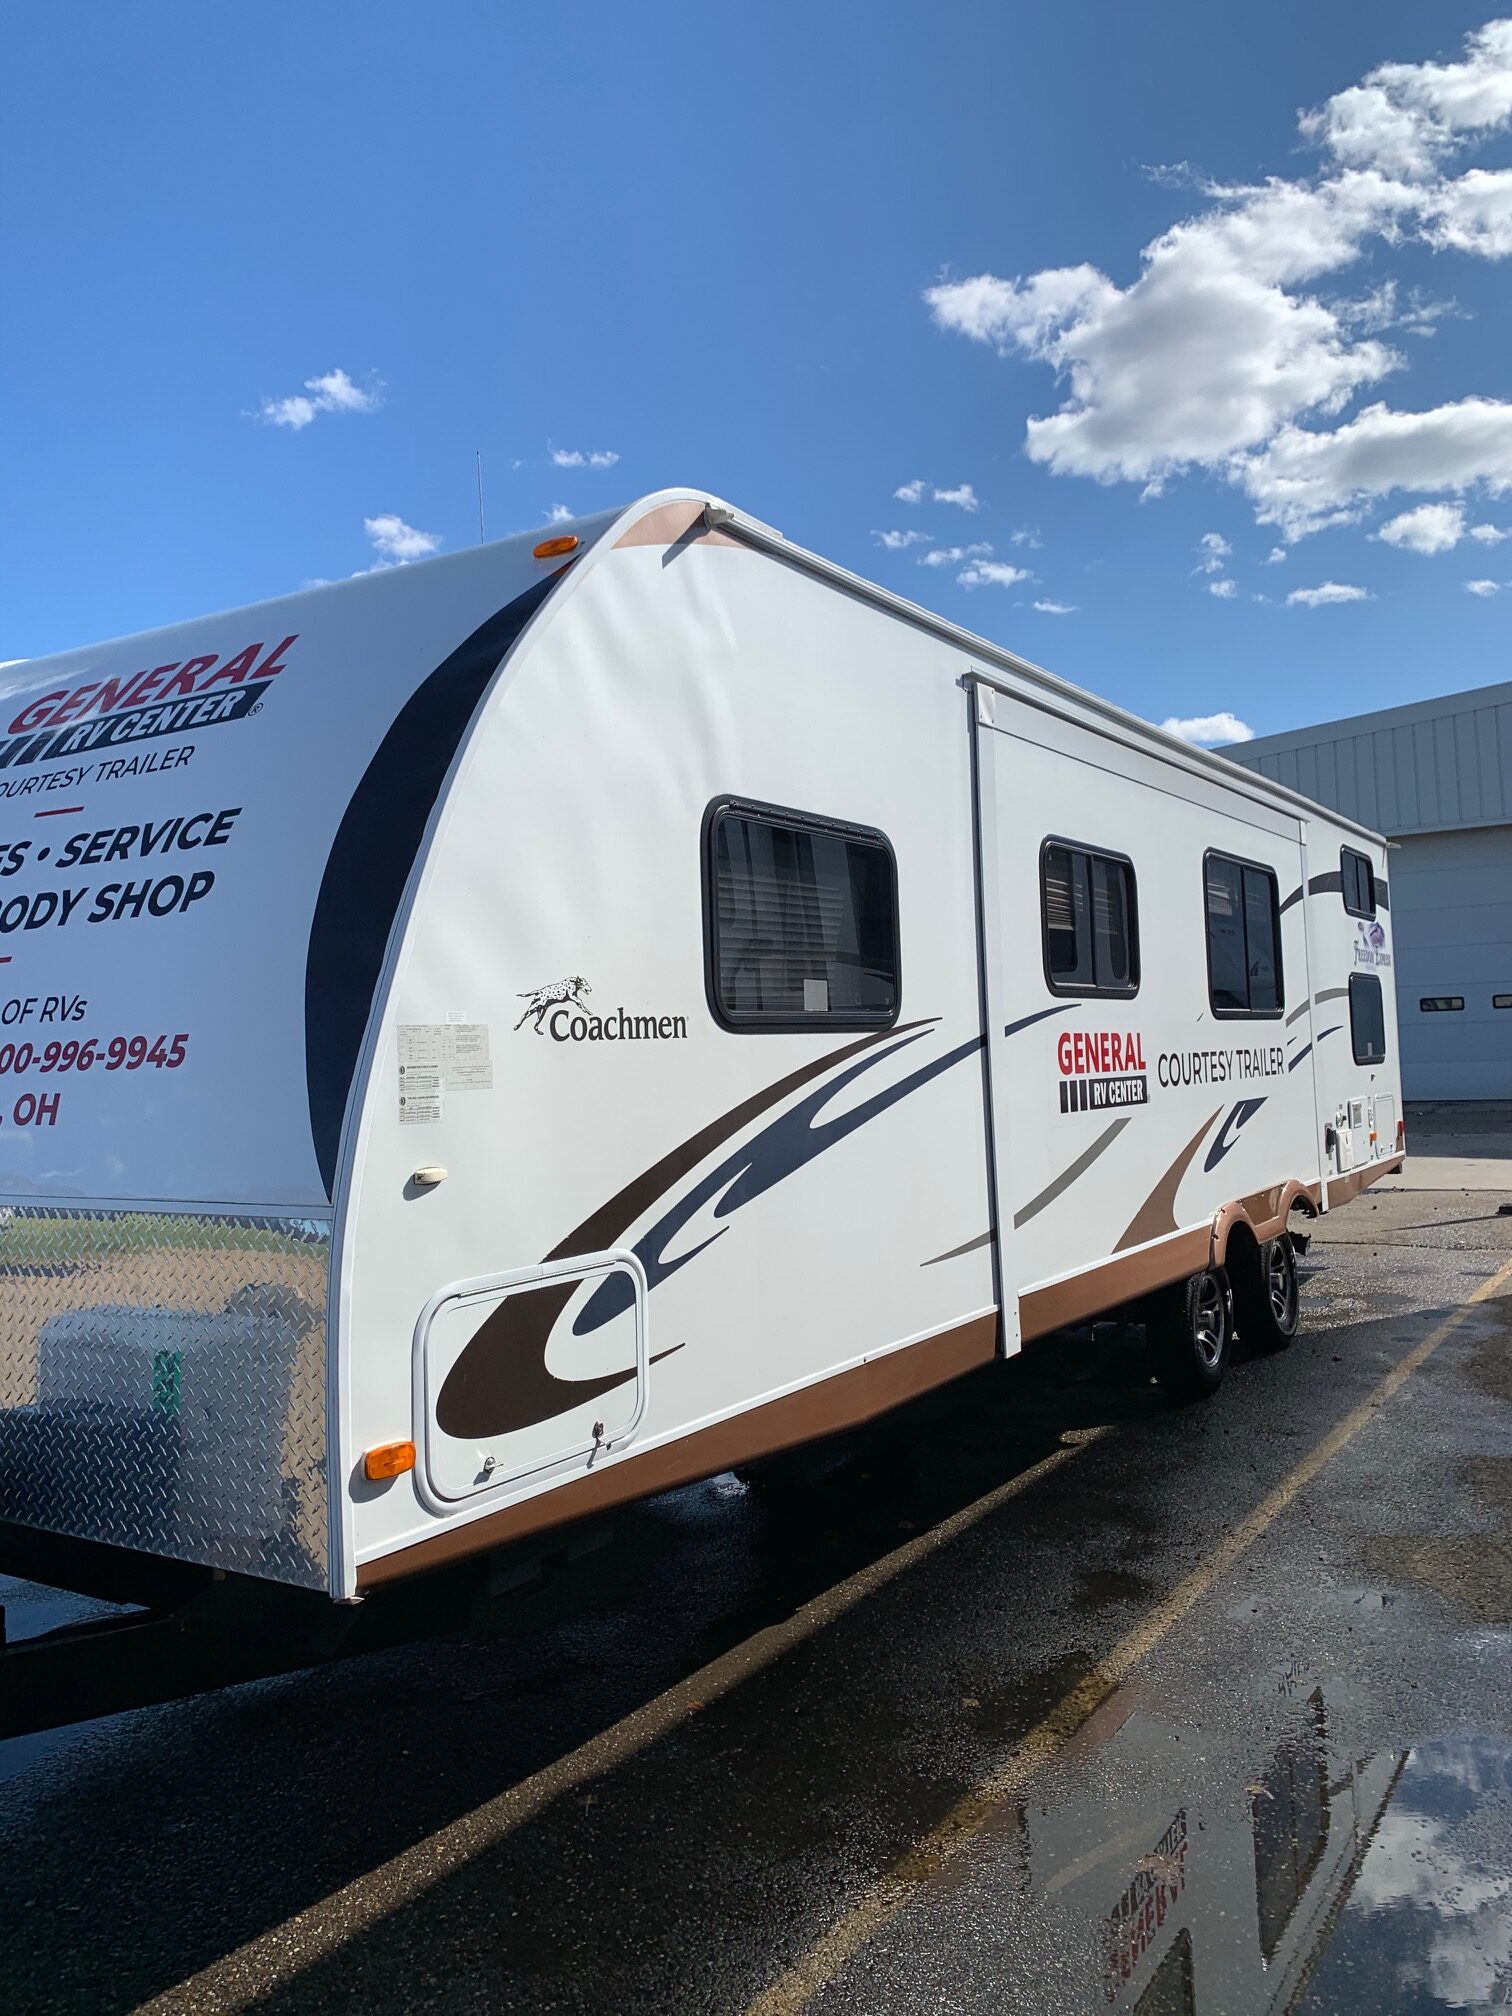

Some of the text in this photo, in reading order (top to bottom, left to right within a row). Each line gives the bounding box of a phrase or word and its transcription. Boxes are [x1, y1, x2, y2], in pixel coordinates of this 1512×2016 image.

[8, 634, 300, 735] GENERAL
[60, 690, 246, 753] RV CENTER
[95, 745, 195, 783] TRAILER
[55, 807, 243, 869] SERVICE
[0, 870, 216, 934] ODY SHOP
[1, 994, 88, 1025] OF RVs
[549, 1007, 688, 1042] Coachmen
[1057, 1032, 1147, 1075] GENERAL
[1157, 1047, 1285, 1088] COURTESY TRAILER
[13, 1092, 61, 1126] OH
[1093, 1079, 1144, 1106] RV CENTER
